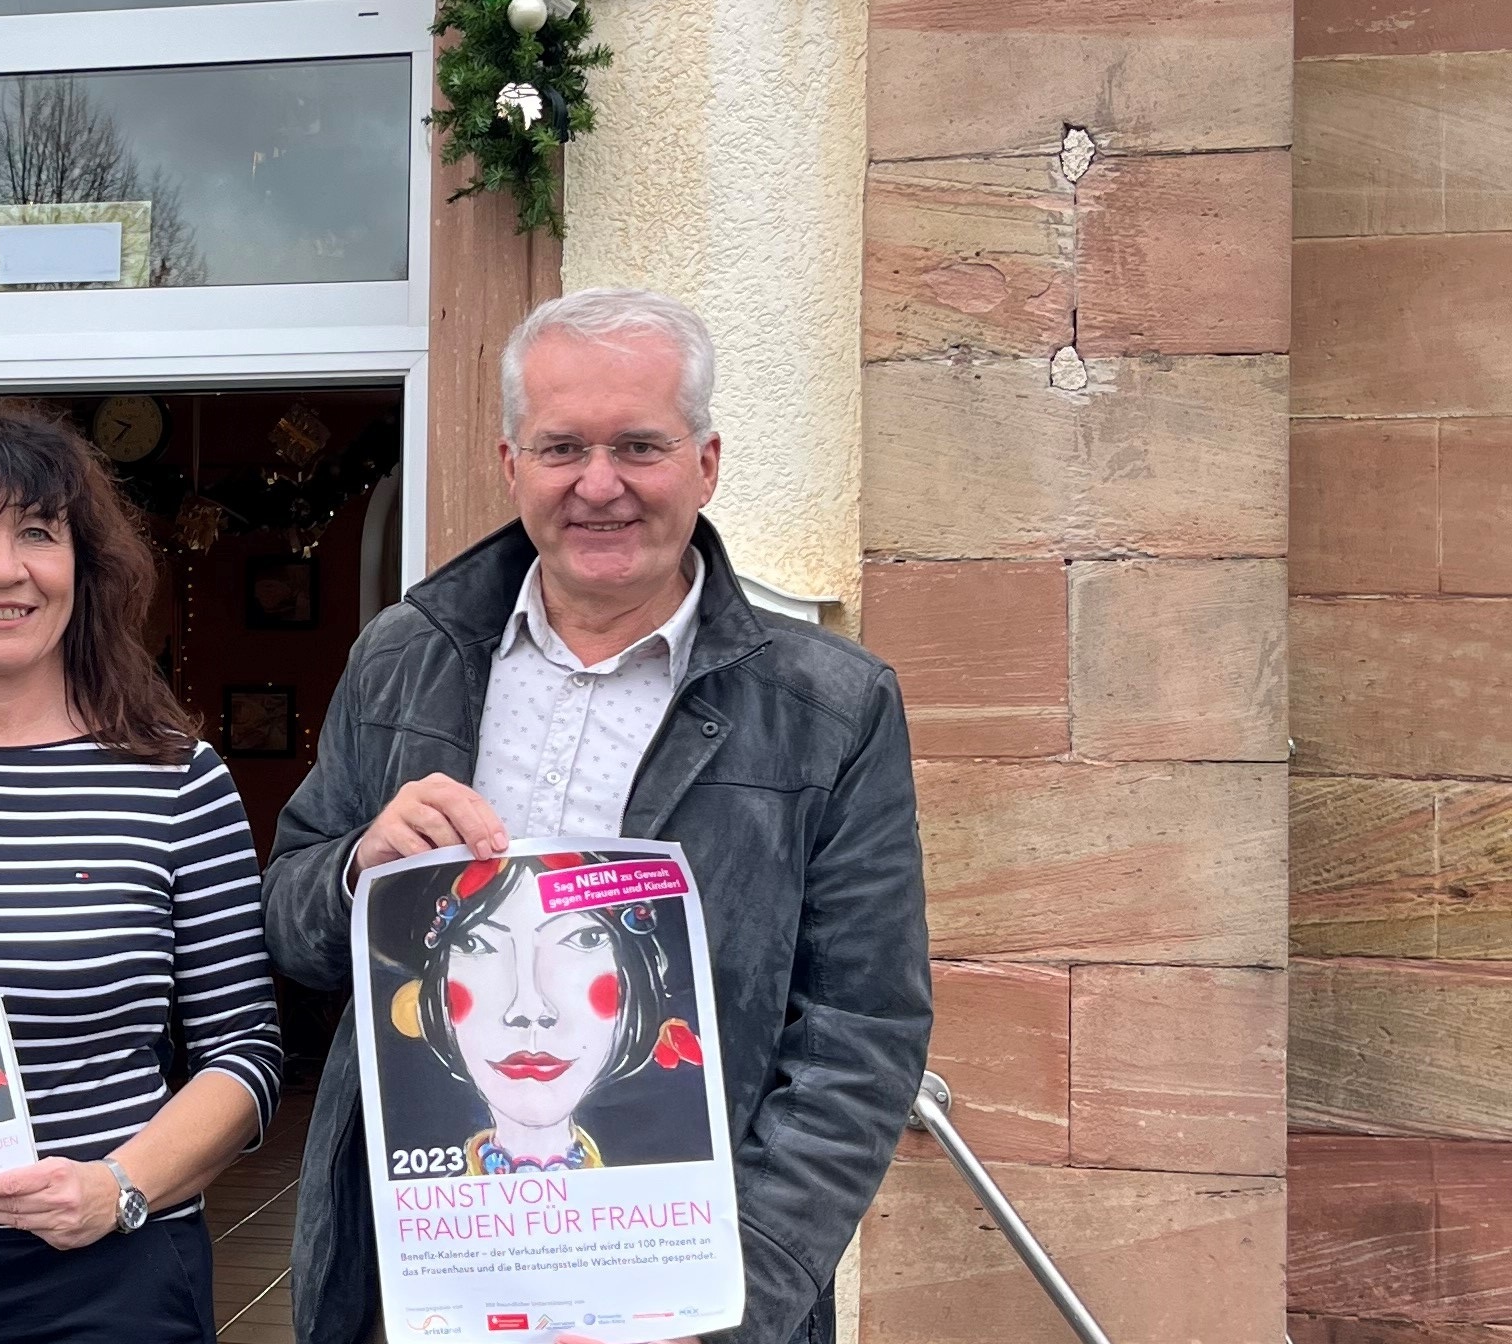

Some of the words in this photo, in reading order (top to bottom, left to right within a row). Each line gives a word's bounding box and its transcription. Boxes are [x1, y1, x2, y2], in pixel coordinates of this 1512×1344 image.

[549, 896, 582, 908] gegen
[584, 889, 620, 901] Frauen
[622, 885, 642, 894] und
[644, 879, 680, 891] Kinder!
[553, 882, 574, 893] Sag
[576, 869, 617, 888] NEIN
[620, 874, 632, 882] zu
[634, 868, 670, 880] Gewalt
[393, 1146, 464, 1175] 2023
[395, 1182, 491, 1211] KUNST
[499, 1177, 567, 1205] VON
[399, 1213, 515, 1242] FRAUEN
[526, 1205, 582, 1235] FÜR
[592, 1200, 712, 1232] FRAUEN
[401, 1249, 480, 1262] Benefiz-Kalender
[490, 1248, 505, 1257] der
[508, 1242, 573, 1256] Verkaufserlös
[576, 1241, 597, 1252] wird
[600, 1240, 621, 1250] wird
[623, 1242, 635, 1250] zu
[638, 1239, 656, 1248] 100
[659, 1237, 697, 1247] Prozent
[699, 1237, 711, 1245] an
[402, 1266, 419, 1277] das
[421, 1264, 475, 1275] Frauenhaus
[477, 1263, 495, 1273] und
[497, 1262, 512, 1272] die
[514, 1259, 588, 1272] Beratungsstelle
[591, 1255, 659, 1267] Wächtersbach
